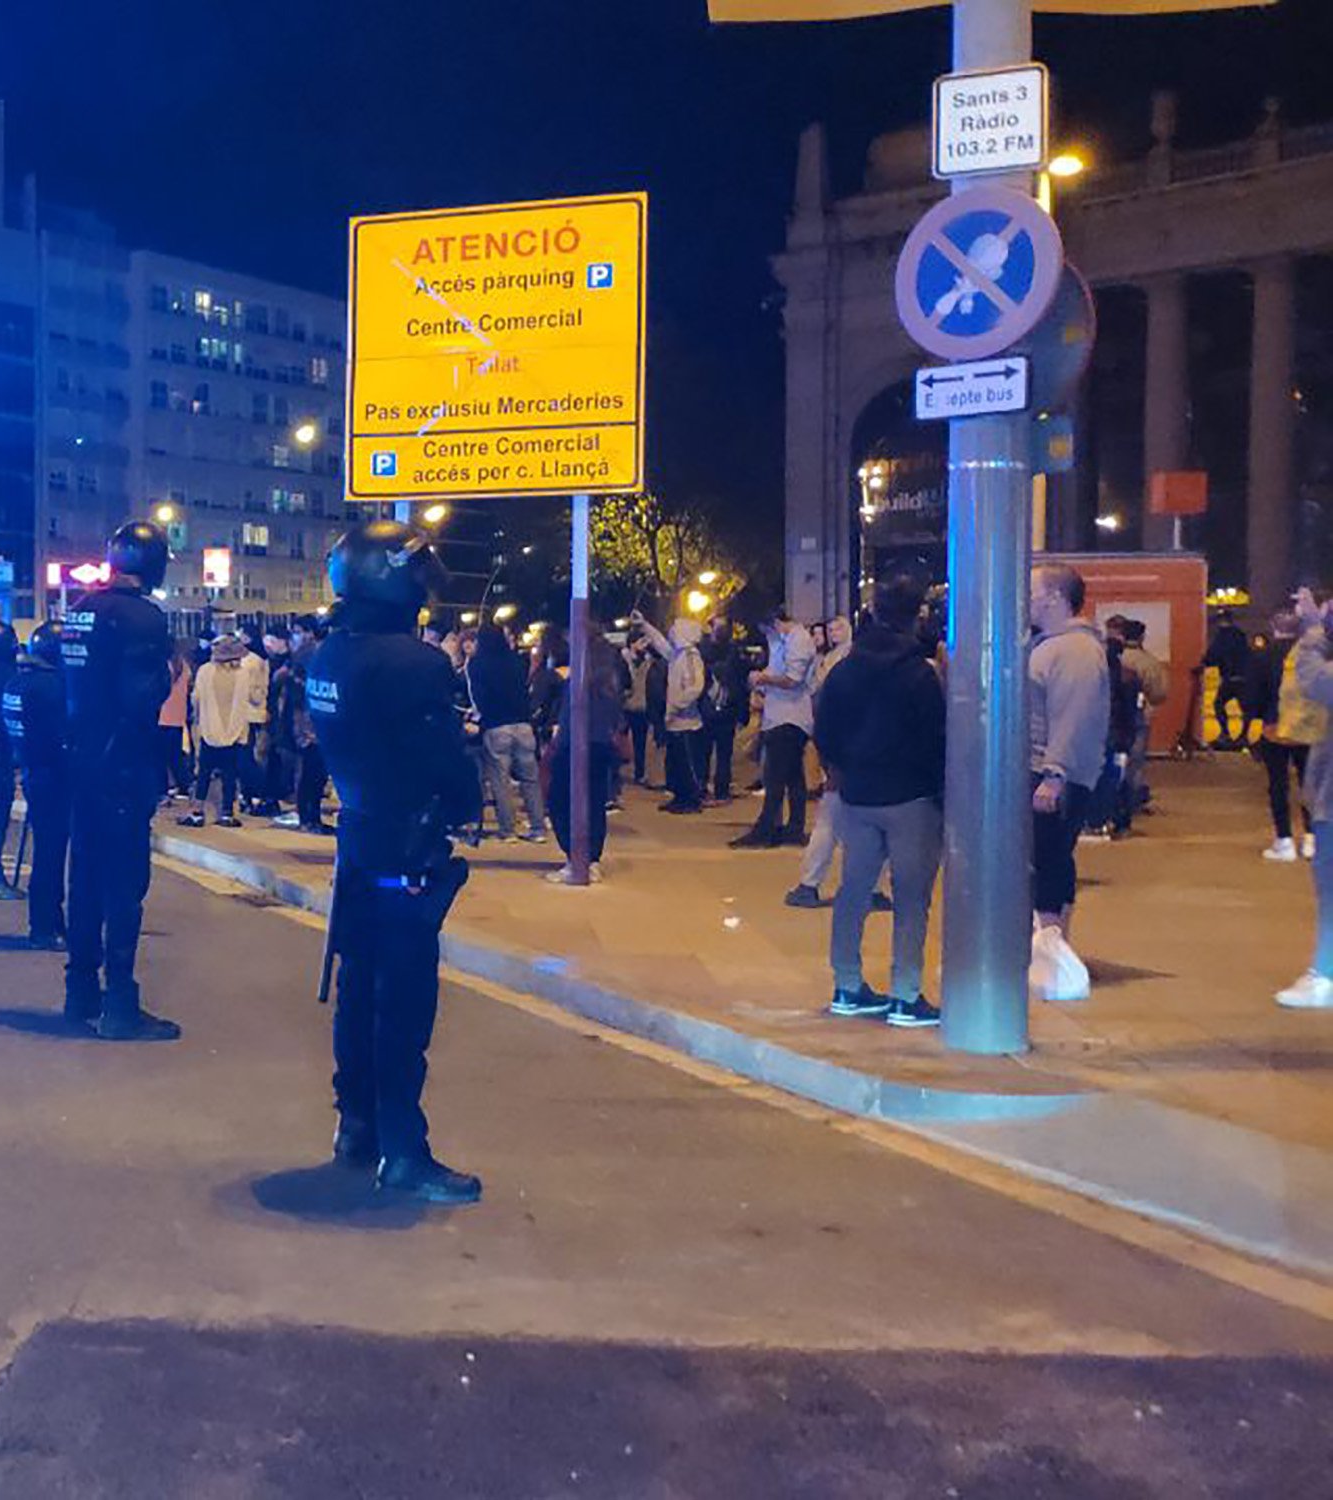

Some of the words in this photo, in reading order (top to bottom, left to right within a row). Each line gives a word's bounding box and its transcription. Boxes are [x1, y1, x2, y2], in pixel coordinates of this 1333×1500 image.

[952, 90, 1009, 108] Sants
[1015, 85, 1028, 101] 3
[960, 112, 1019, 132] Ràdio
[947, 138, 998, 158] 103.2
[1004, 134, 1034, 152] FM
[412, 220, 580, 265] ATENCIÓ
[416, 274, 475, 295] Accés
[406, 317, 472, 337] Centre
[478, 308, 583, 333] Comercial
[365, 402, 400, 421] Pas
[406, 398, 490, 419] exclusiu
[497, 392, 624, 415] Mercaderies
[925, 391, 982, 408] Eepte
[987, 386, 1014, 402] bus
[423, 440, 489, 459] Centre
[496, 433, 600, 454] Comercial
[413, 465, 470, 484] accés
[478, 466, 509, 484] per
[516, 465, 533, 479] c.
